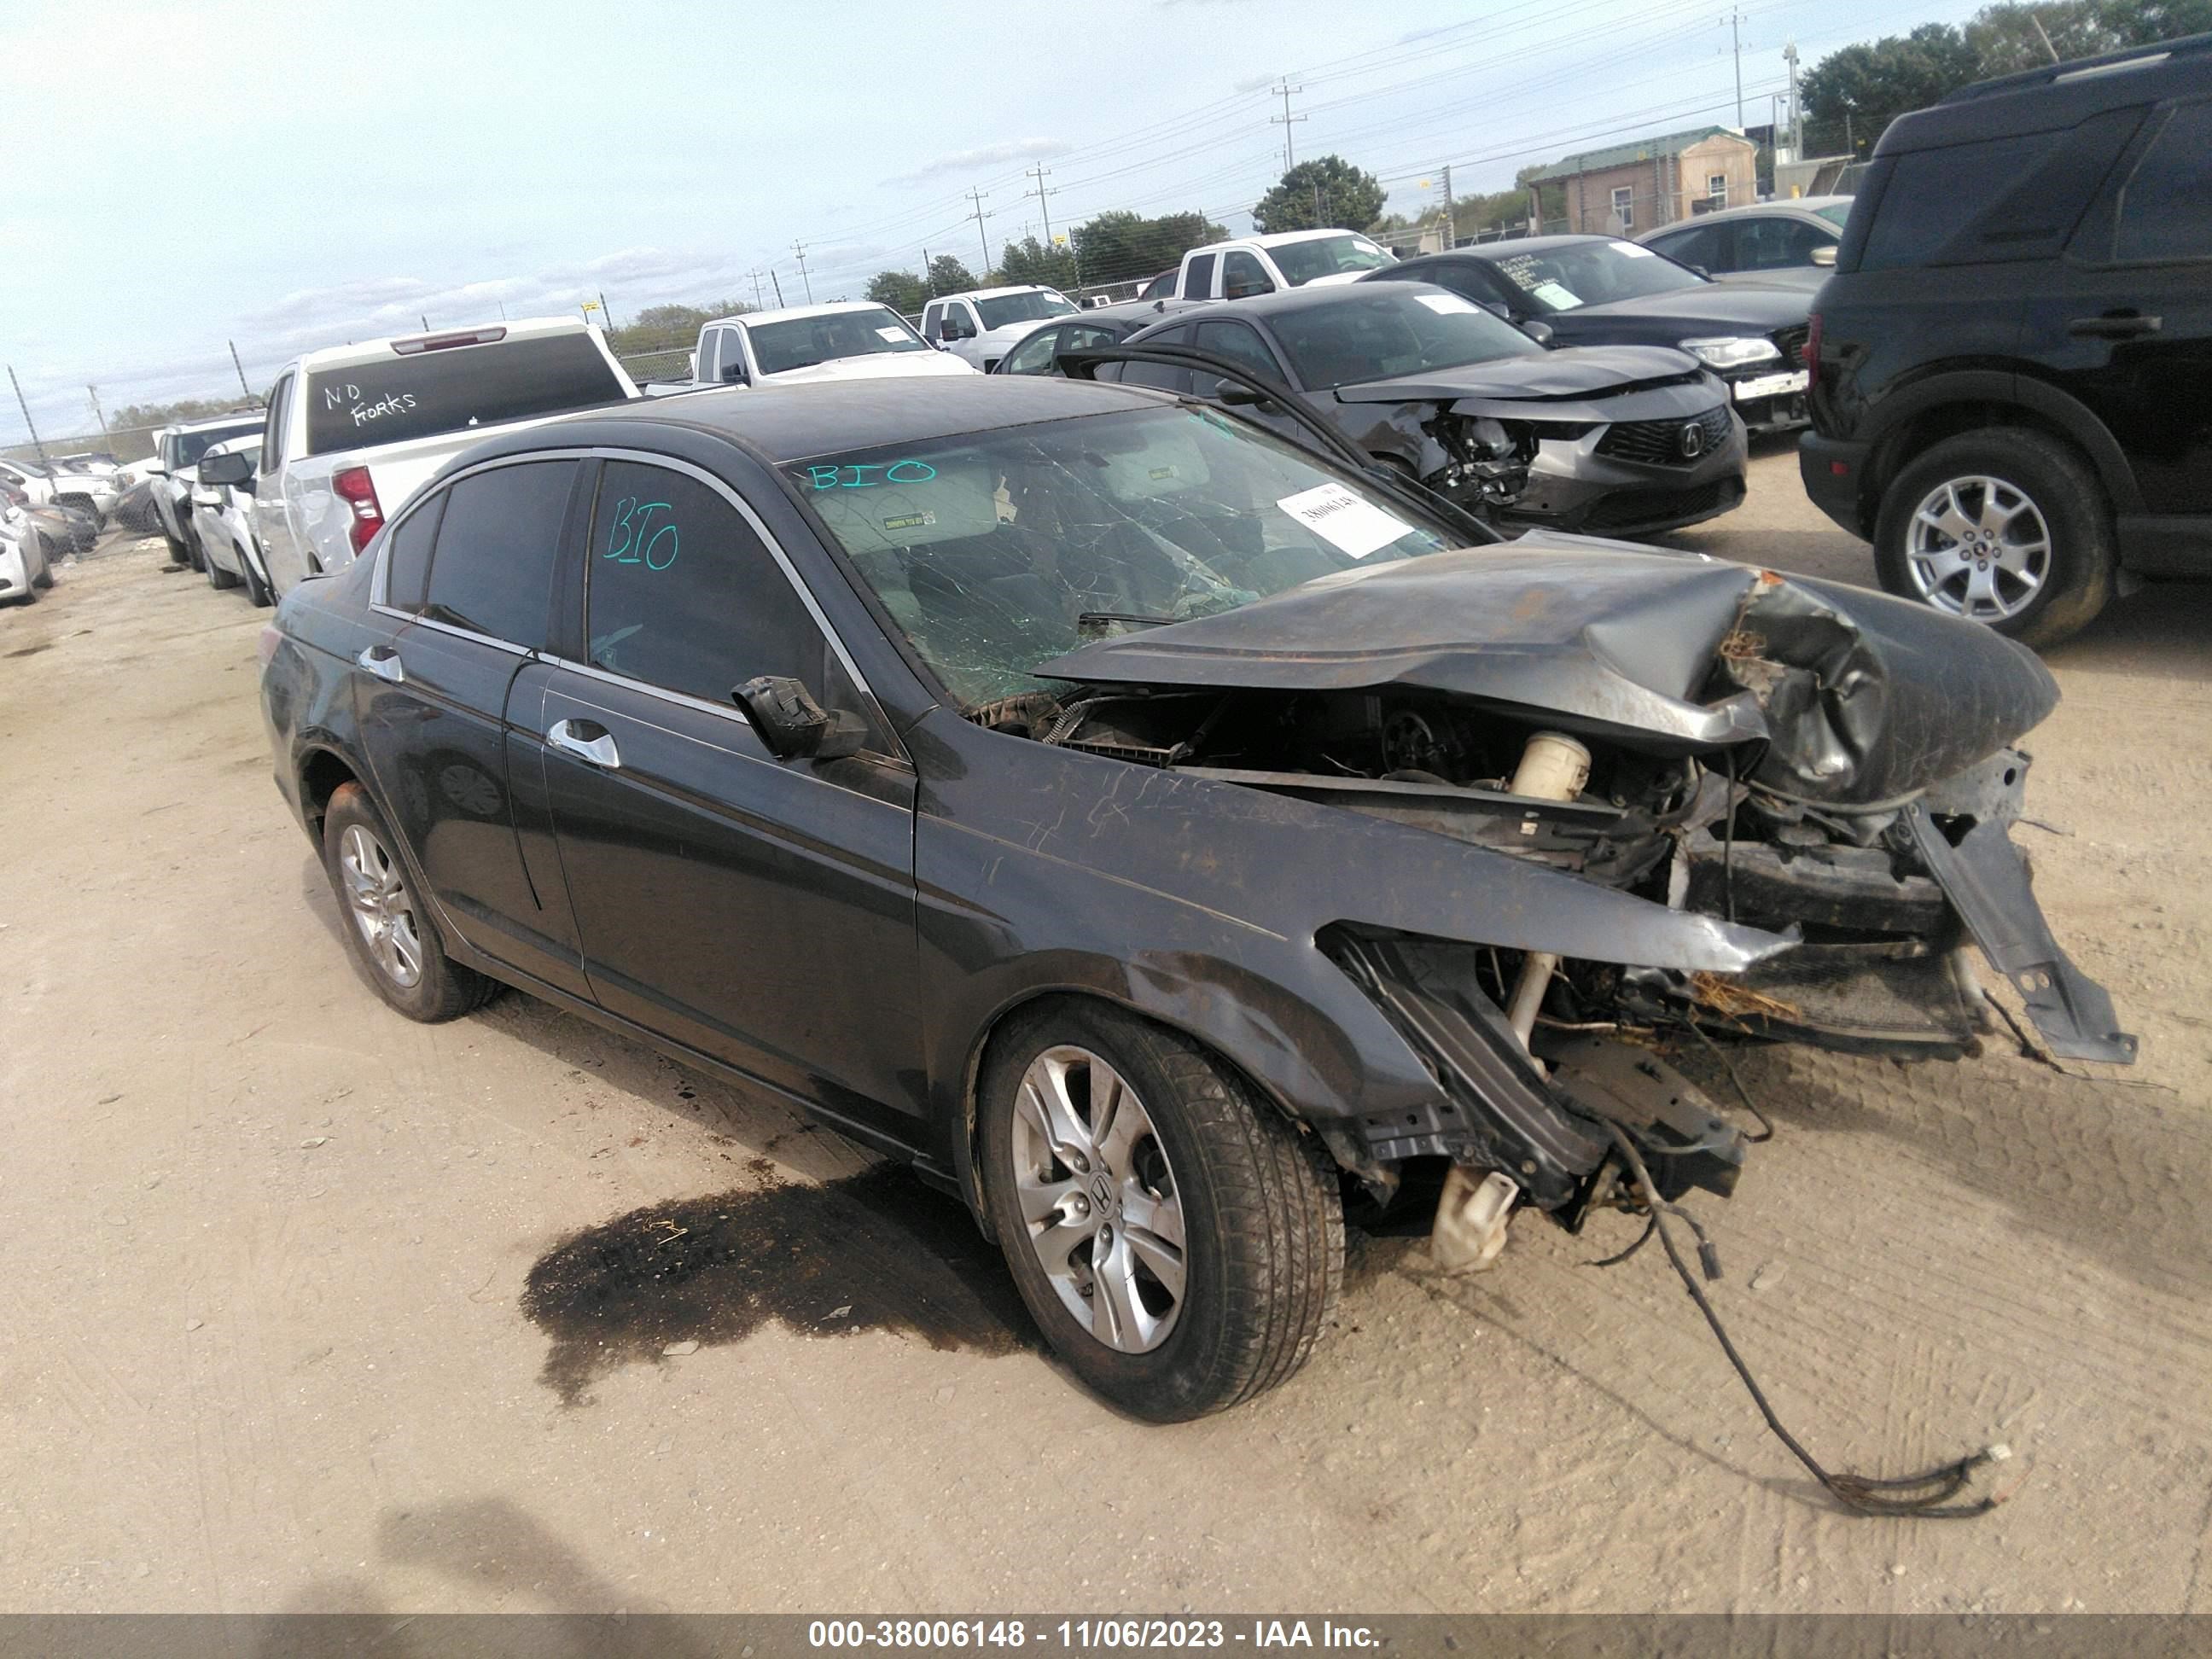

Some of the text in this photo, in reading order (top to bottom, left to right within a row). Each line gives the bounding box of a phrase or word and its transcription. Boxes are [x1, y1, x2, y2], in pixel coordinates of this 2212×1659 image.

[350, 393, 416, 427] FORKS
[806, 460, 937, 490] BIO
[602, 497, 678, 570] BIO
